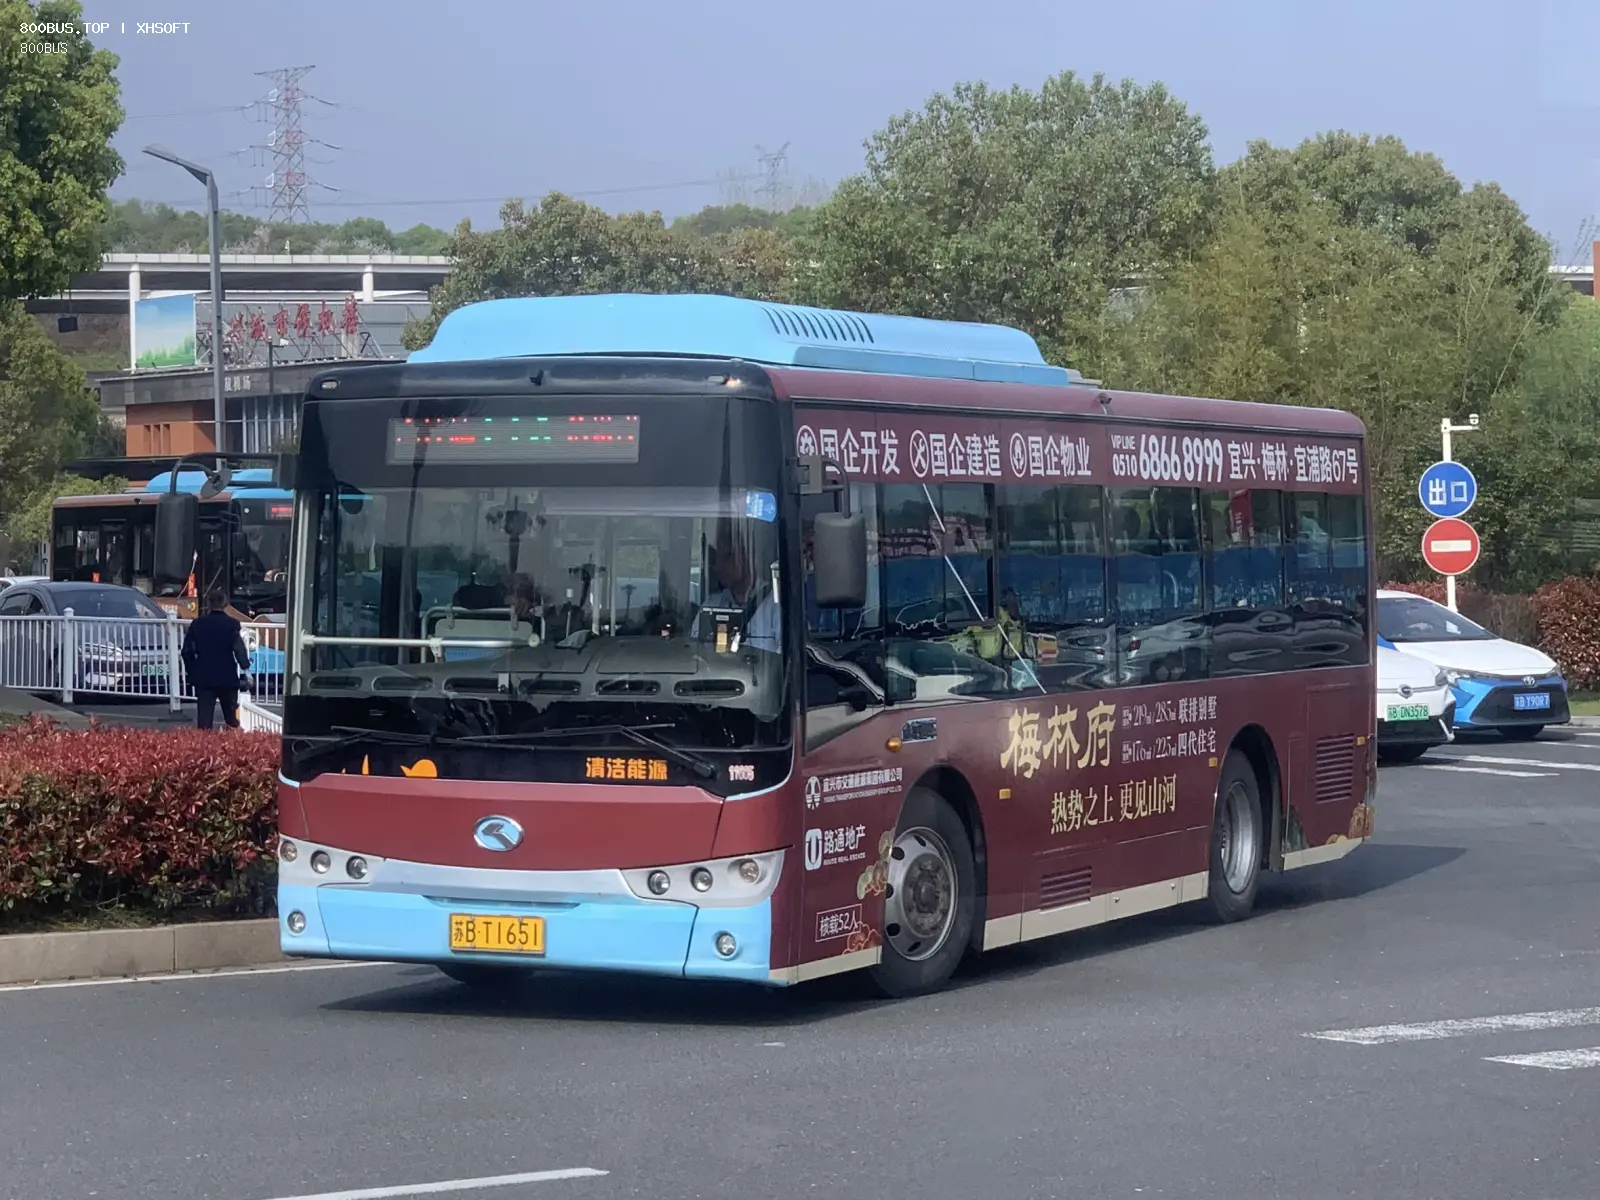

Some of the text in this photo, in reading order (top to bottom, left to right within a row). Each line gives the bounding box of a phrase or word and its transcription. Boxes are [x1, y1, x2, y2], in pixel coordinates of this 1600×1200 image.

[930, 432, 1002, 477] 国企建造
[1028, 435, 1092, 477] 国企物业
[1112, 453, 1137, 476] 0510
[1428, 478, 1468, 505] 出口
[1000, 700, 1116, 779] 梅林府
[586, 757, 668, 780] 清洁能源
[1051, 773, 1177, 834] 热势之上 更见山河
[823, 824, 866, 854] 路通地产
